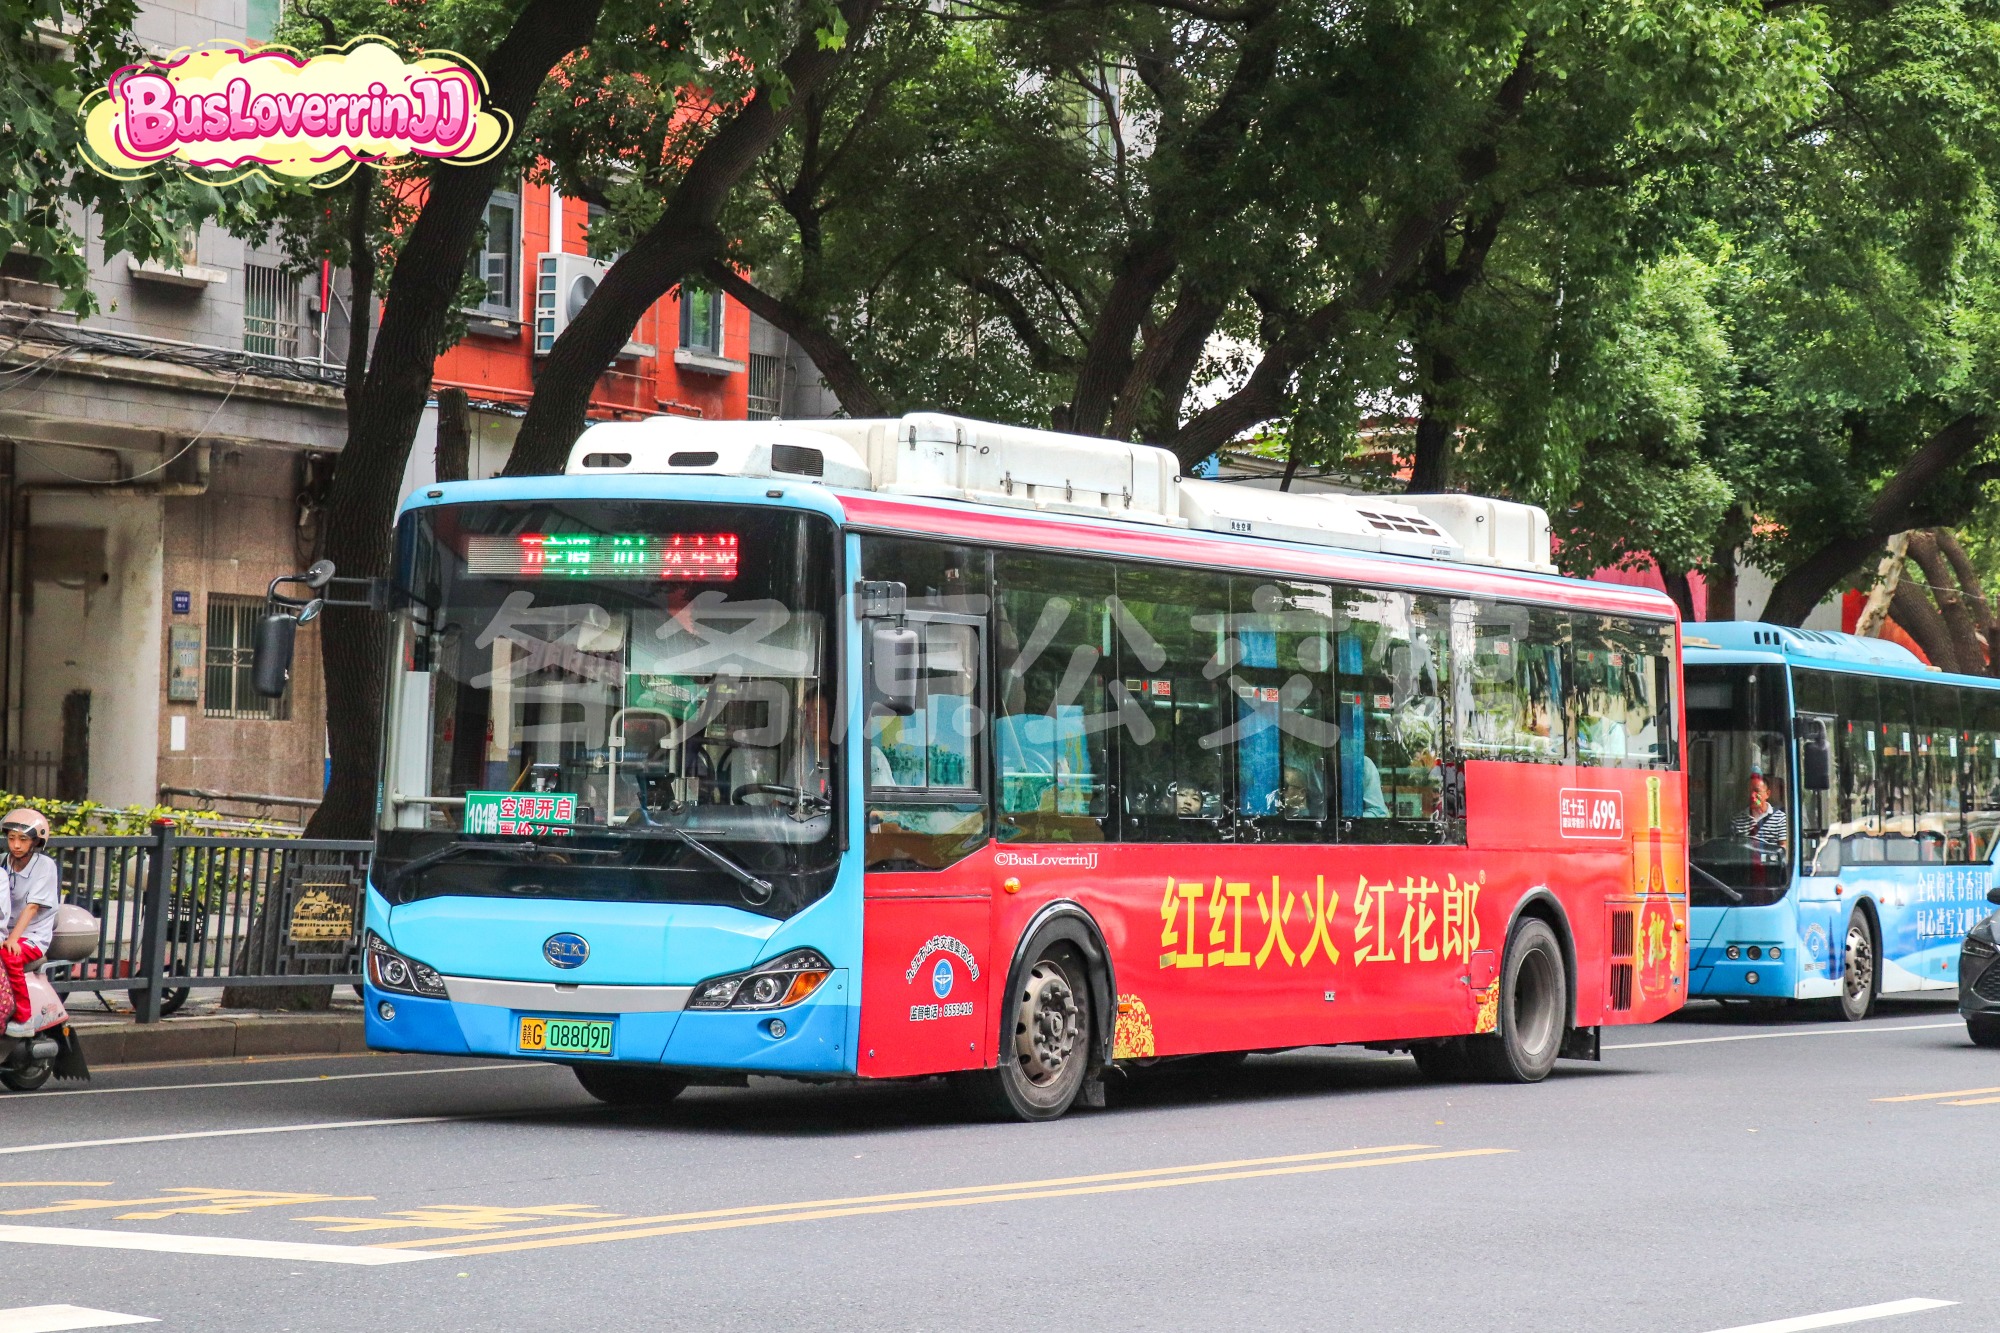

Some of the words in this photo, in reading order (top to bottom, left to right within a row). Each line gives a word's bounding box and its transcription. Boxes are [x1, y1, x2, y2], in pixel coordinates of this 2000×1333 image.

[500, 797, 573, 820] 空调开启
[1562, 798, 1585, 816] 红十五
[1160, 874, 1340, 970] 红红火火
[905, 935, 980, 984] 九江市公共交通集团公司
